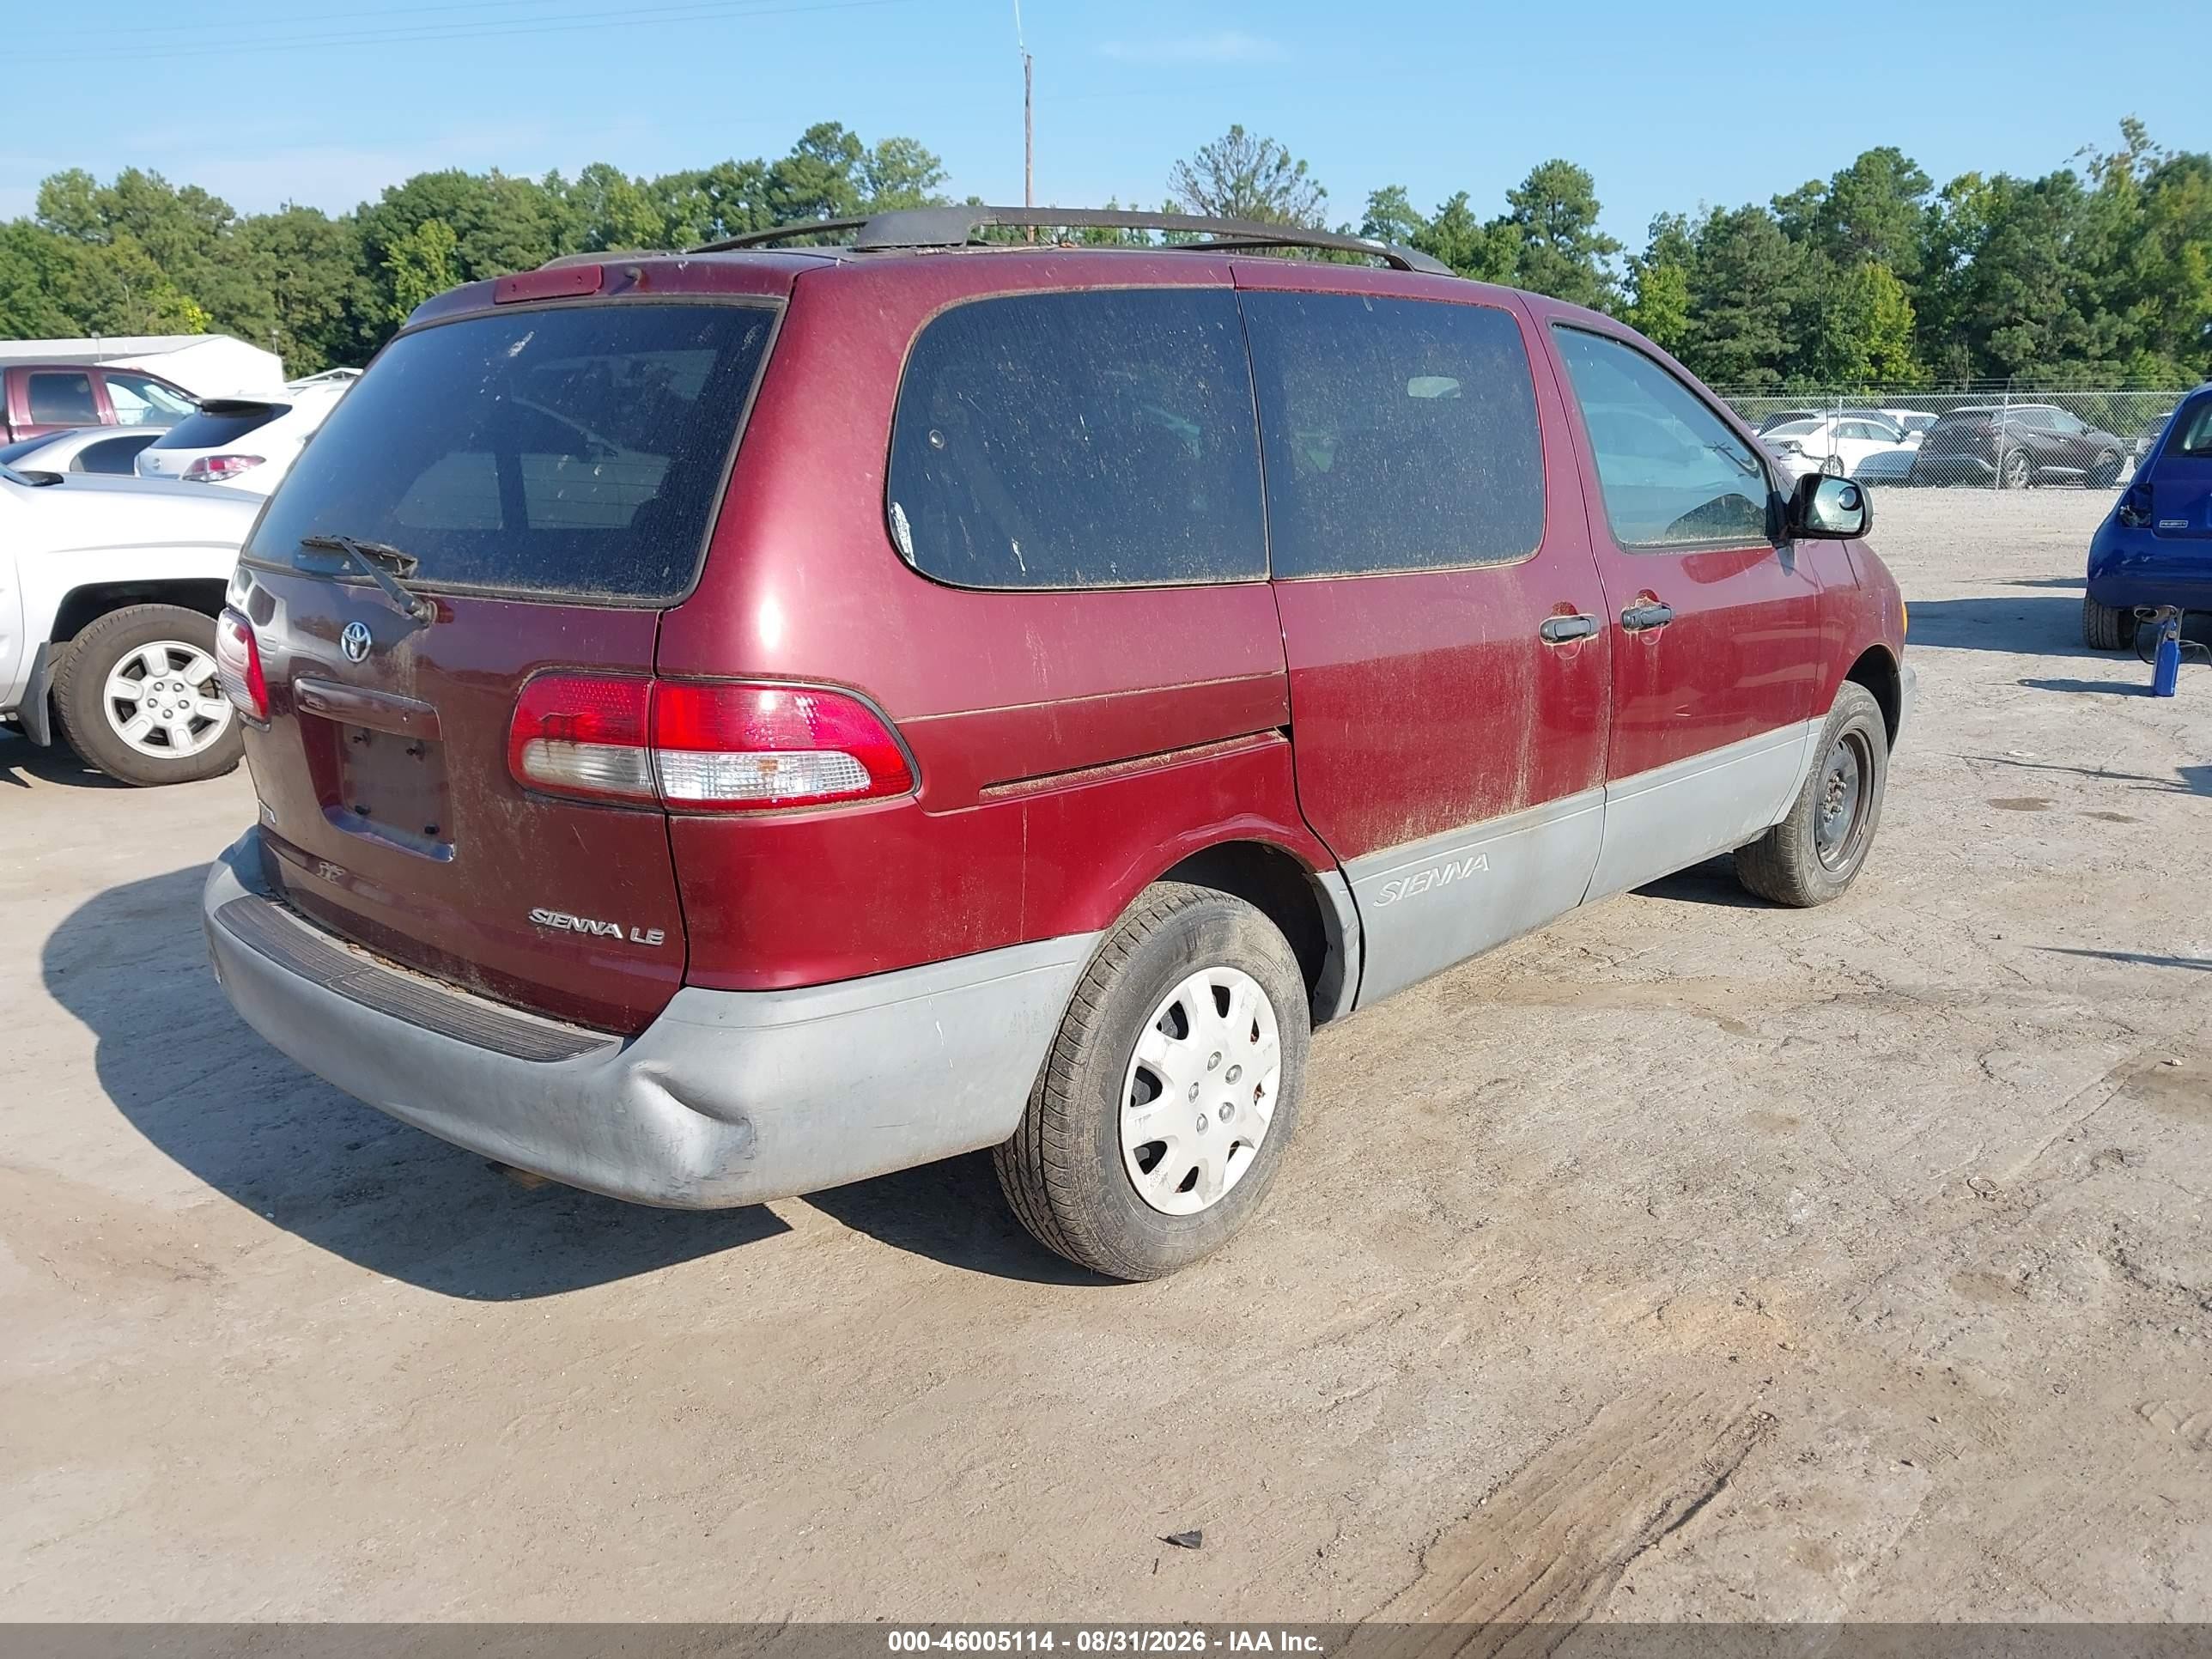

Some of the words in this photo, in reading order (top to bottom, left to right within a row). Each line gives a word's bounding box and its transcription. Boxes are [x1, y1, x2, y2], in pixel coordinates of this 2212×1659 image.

[1373, 853, 1490, 907] SIENNA
[529, 908, 623, 939] SIENNA
[629, 927, 665, 946] LE
